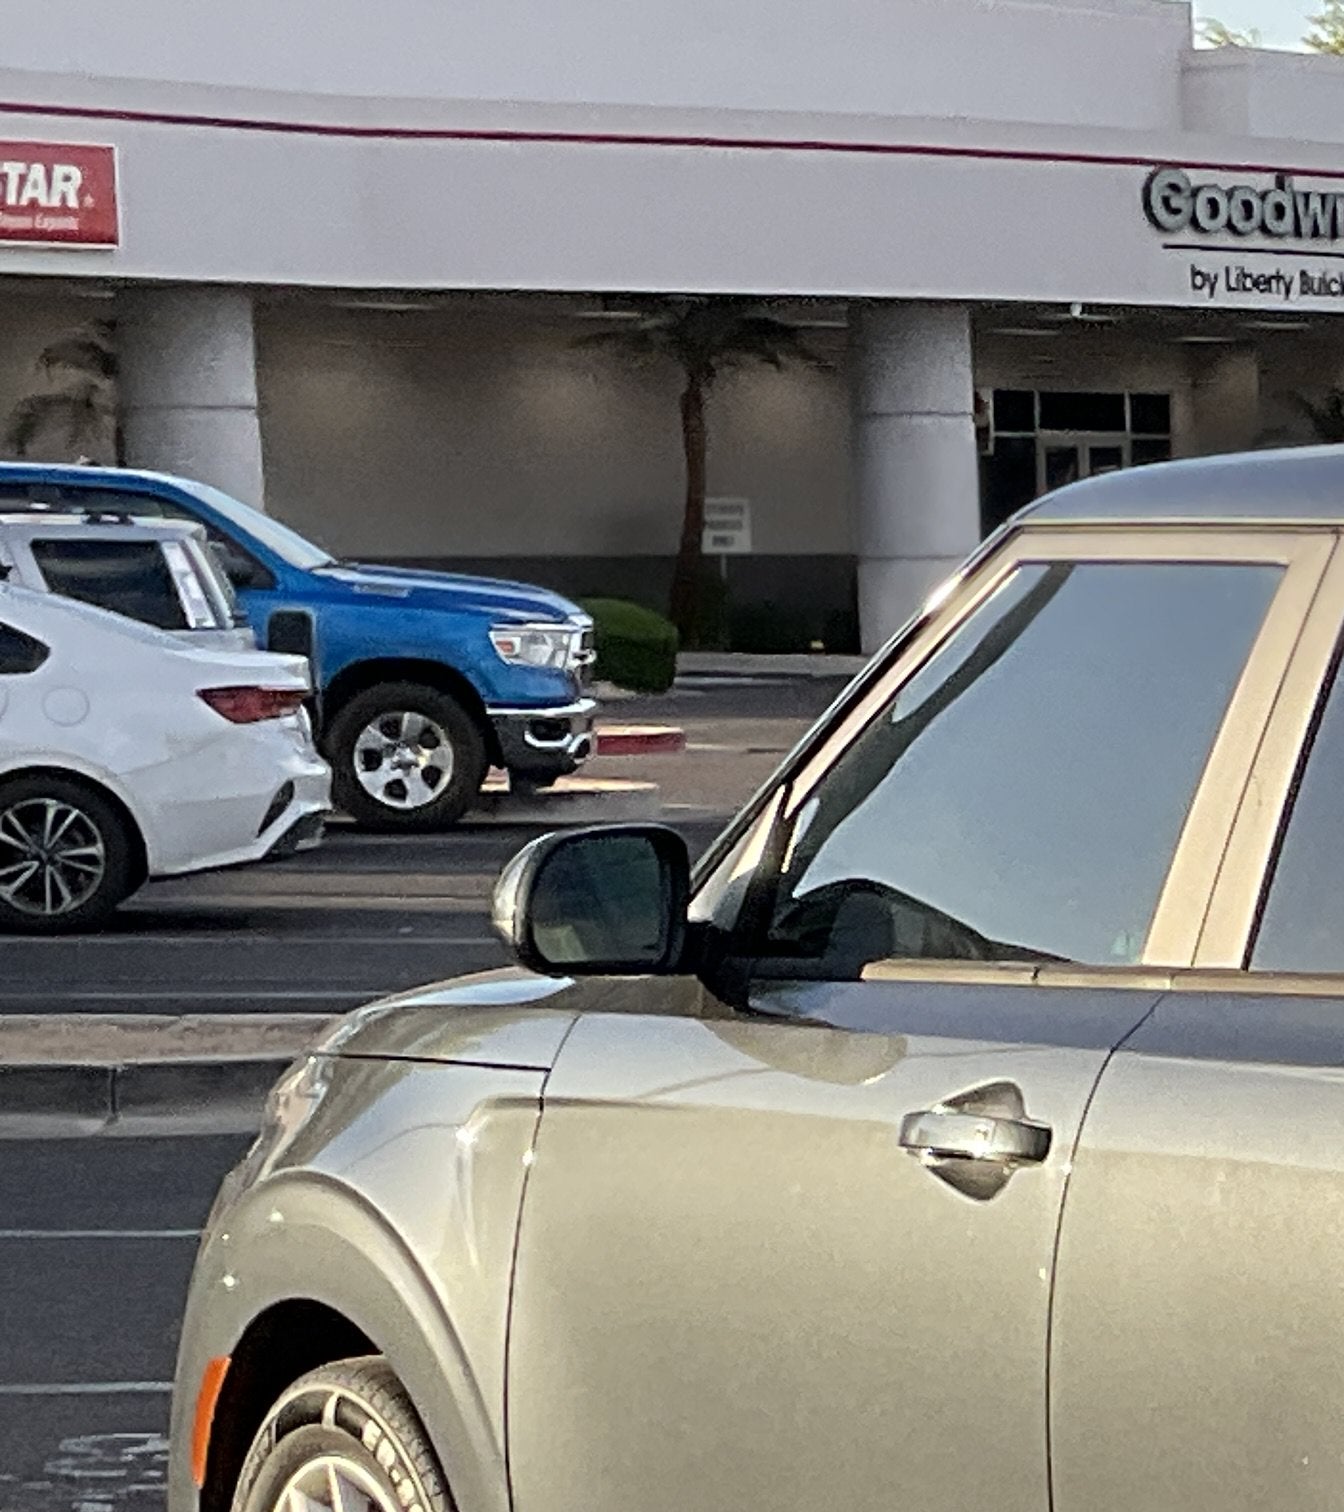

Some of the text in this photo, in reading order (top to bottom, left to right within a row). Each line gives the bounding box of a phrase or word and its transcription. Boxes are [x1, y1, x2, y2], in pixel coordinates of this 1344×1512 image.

[0, 162, 82, 208] TAR
[1190, 263, 1218, 299] by
[1225, 266, 1294, 300] Liberty
